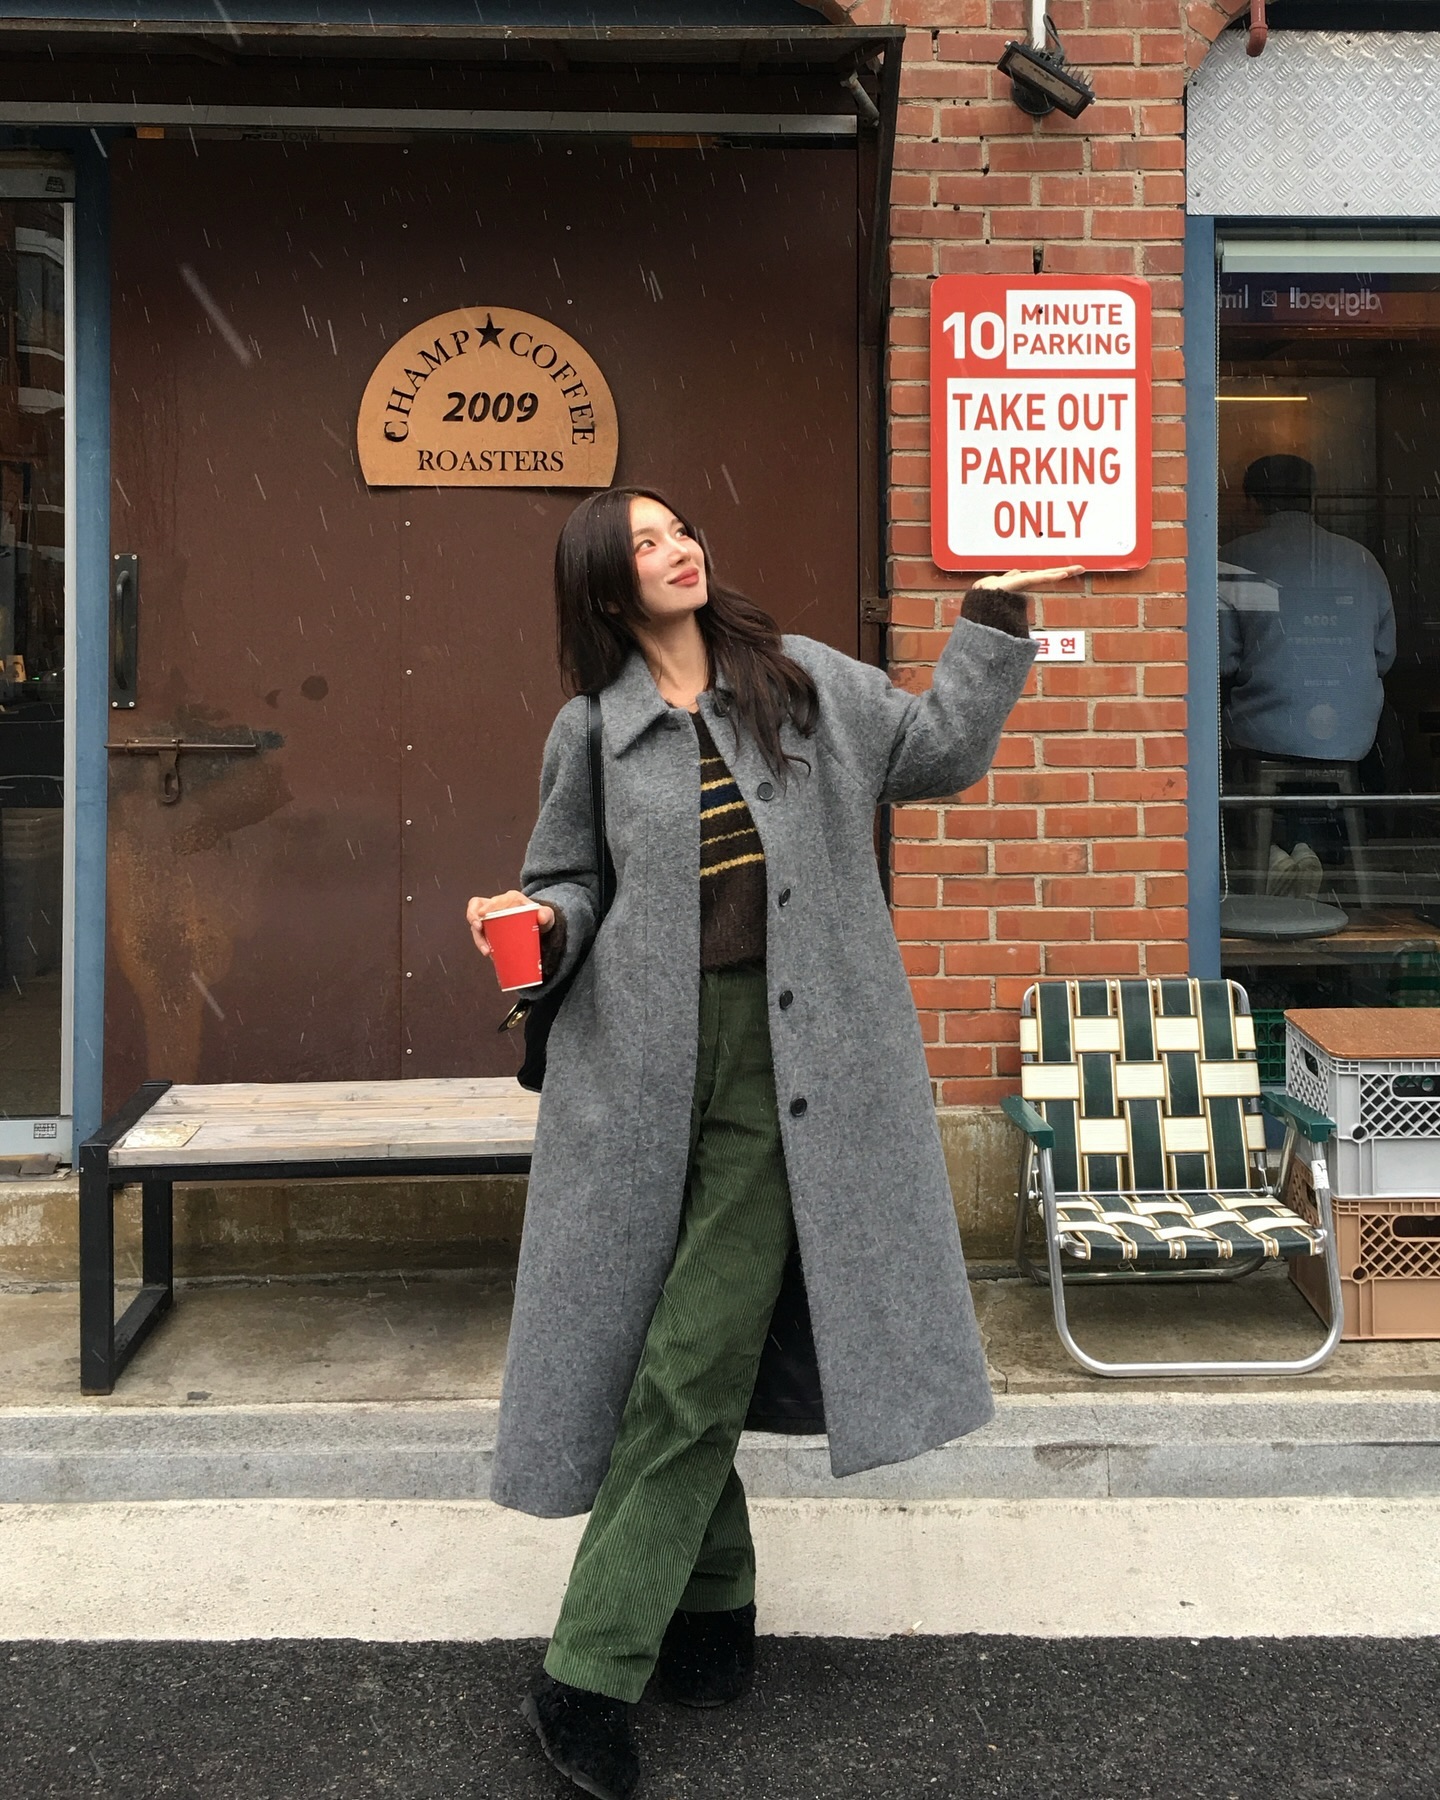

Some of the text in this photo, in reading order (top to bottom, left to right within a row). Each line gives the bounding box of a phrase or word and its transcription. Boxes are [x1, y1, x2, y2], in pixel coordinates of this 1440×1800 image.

[1021, 303, 1122, 325] MINUTE
[942, 312, 1005, 360] 10
[1013, 333, 1130, 355] PARKING
[384, 329, 596, 446] CHAMP COFFEE
[442, 391, 539, 423] 2009
[952, 393, 1129, 431] TAKE OUT
[417, 449, 564, 472] ROASTERS
[961, 446, 1121, 485] PARKING
[994, 500, 1089, 539] ONLY
